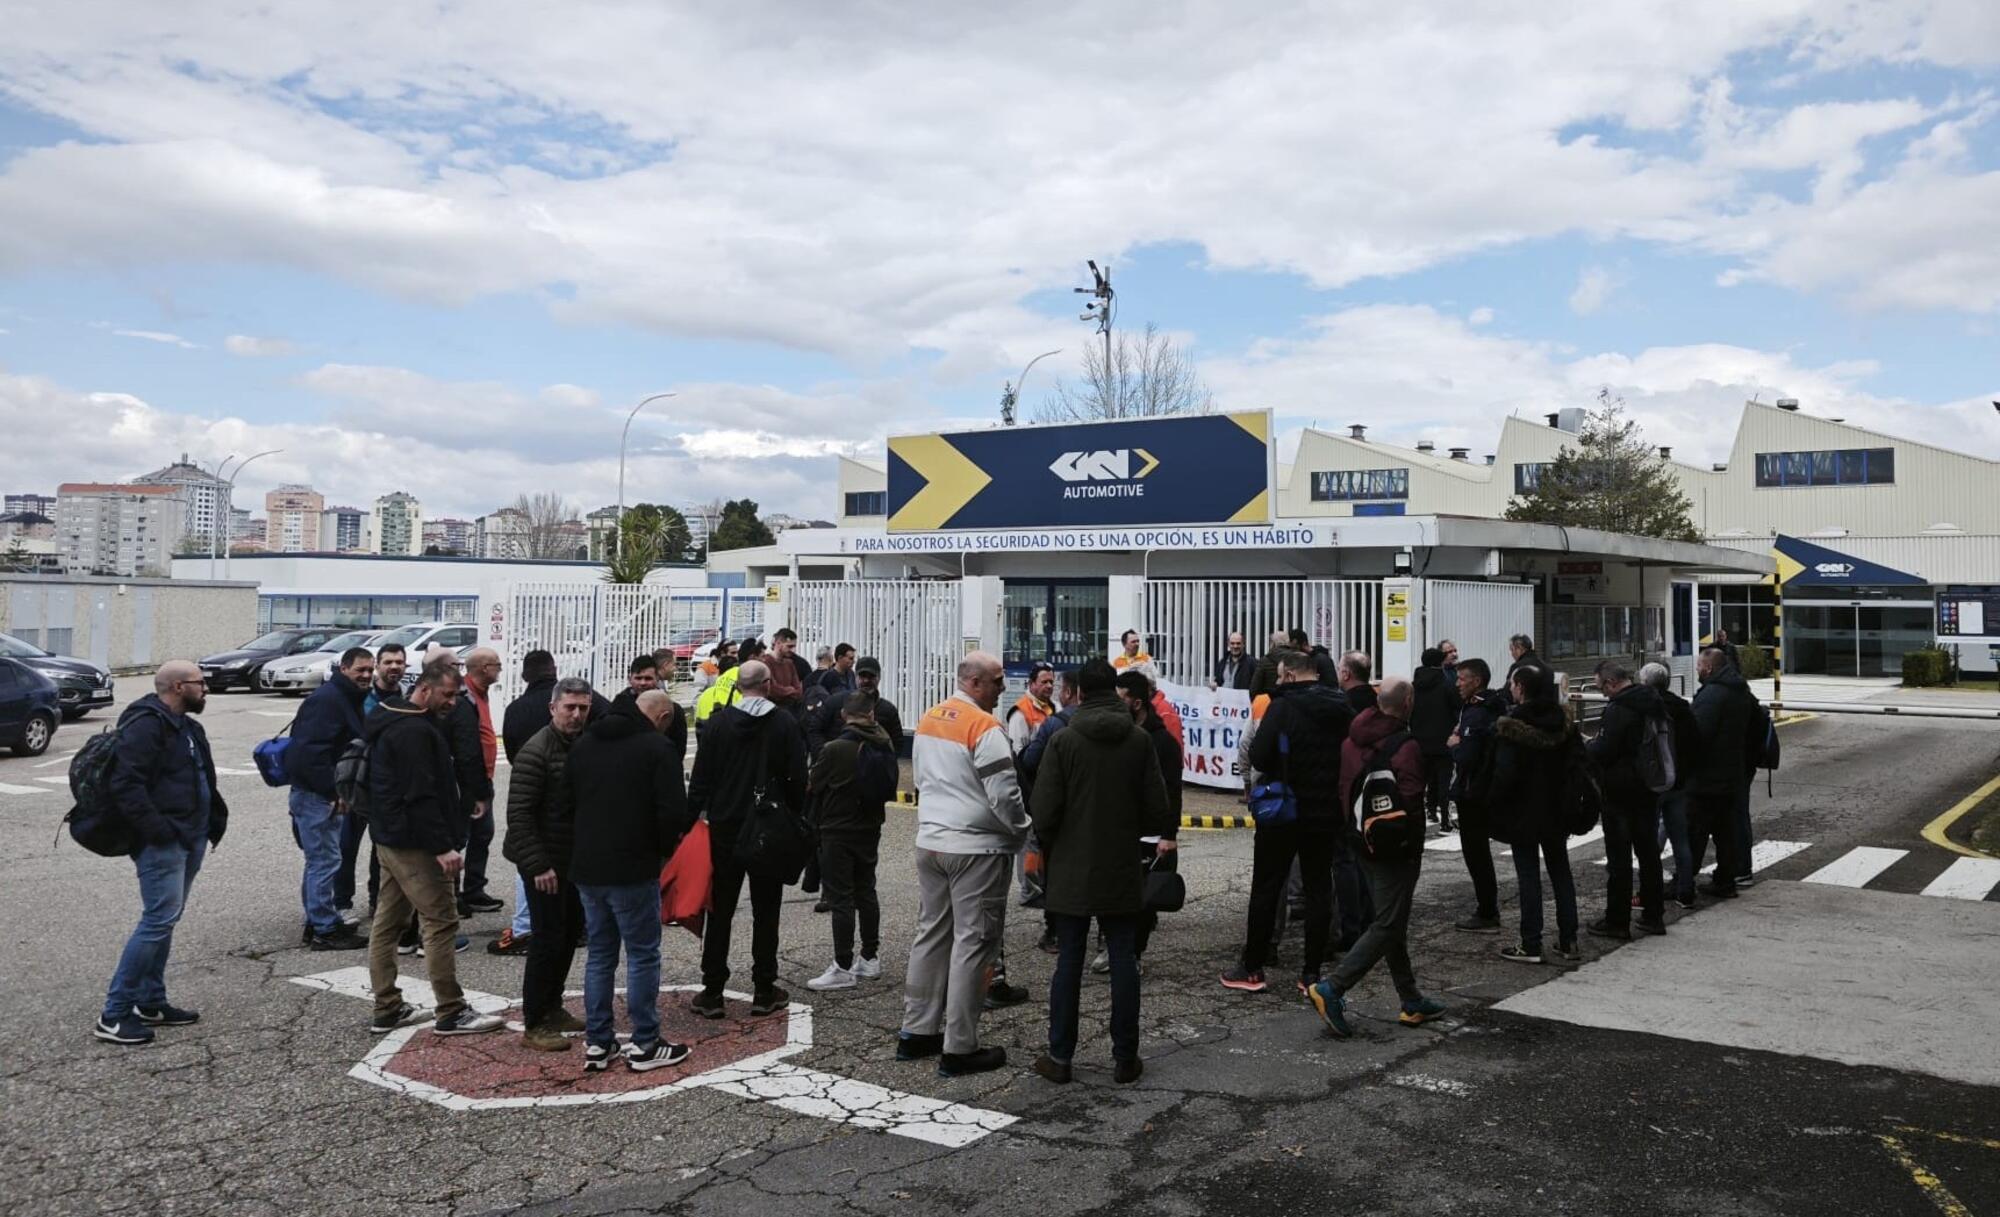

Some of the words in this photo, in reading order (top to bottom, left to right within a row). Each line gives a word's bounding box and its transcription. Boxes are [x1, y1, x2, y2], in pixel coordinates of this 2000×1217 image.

[1048, 449, 1129, 481] GKN
[1063, 484, 1144, 499] AUTOMOTIVE
[855, 538, 884, 550] PARA
[887, 536, 953, 550] NOSOTROS
[956, 536, 972, 549] LA
[975, 533, 1050, 549] SEGURIDAD
[1054, 533, 1076, 547] NO
[1080, 533, 1094, 547] ES
[1099, 532, 1130, 547] UNA
[1134, 528, 1198, 548] OPCIÓN,
[1203, 531, 1219, 545] ES
[1224, 530, 1248, 545] UN
[1253, 527, 1313, 545] HÁBITO
